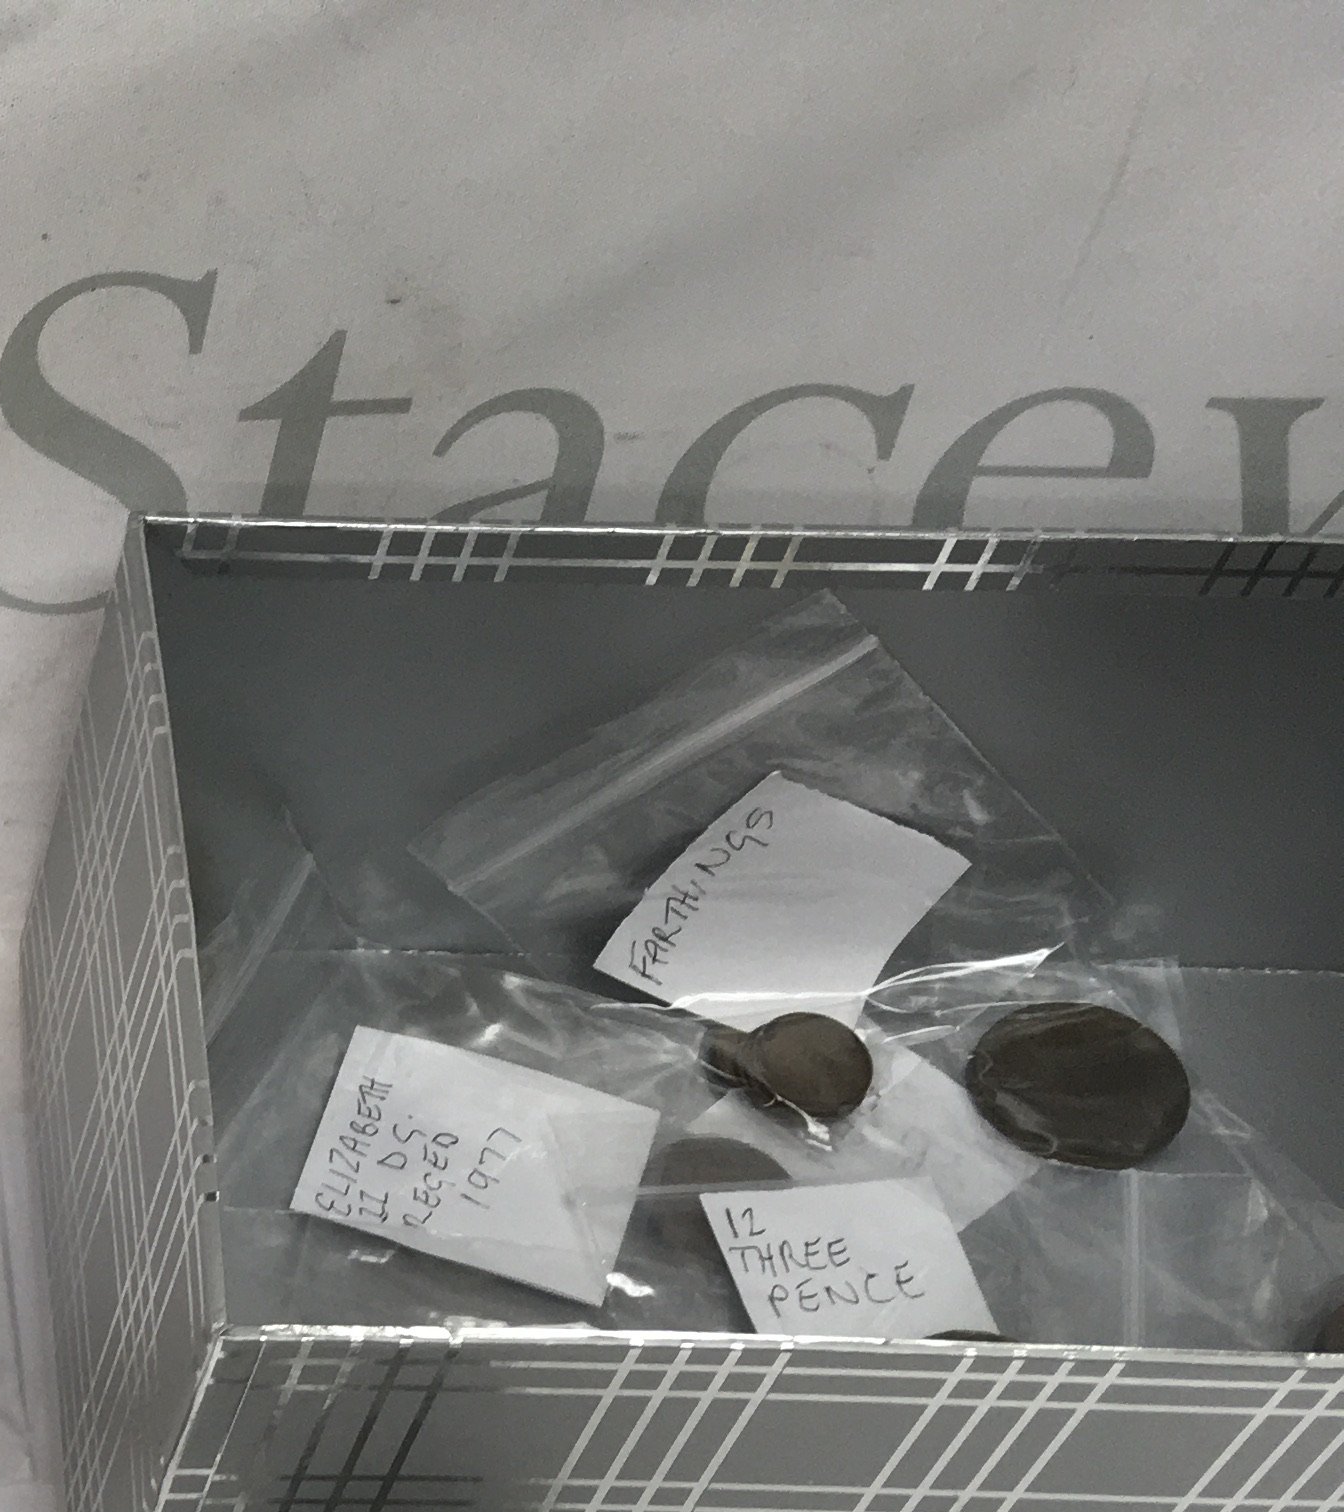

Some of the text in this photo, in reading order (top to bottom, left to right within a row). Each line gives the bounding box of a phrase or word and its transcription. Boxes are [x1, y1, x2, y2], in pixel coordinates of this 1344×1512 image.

[628, 806, 775, 986] FARTHINGS
[314, 1074, 393, 1218] ELIZABETH
[460, 1126, 523, 1210] 1977
[725, 1206, 767, 1239] 12
[729, 1236, 852, 1279] THREE
[768, 1260, 926, 1319] PENCE
